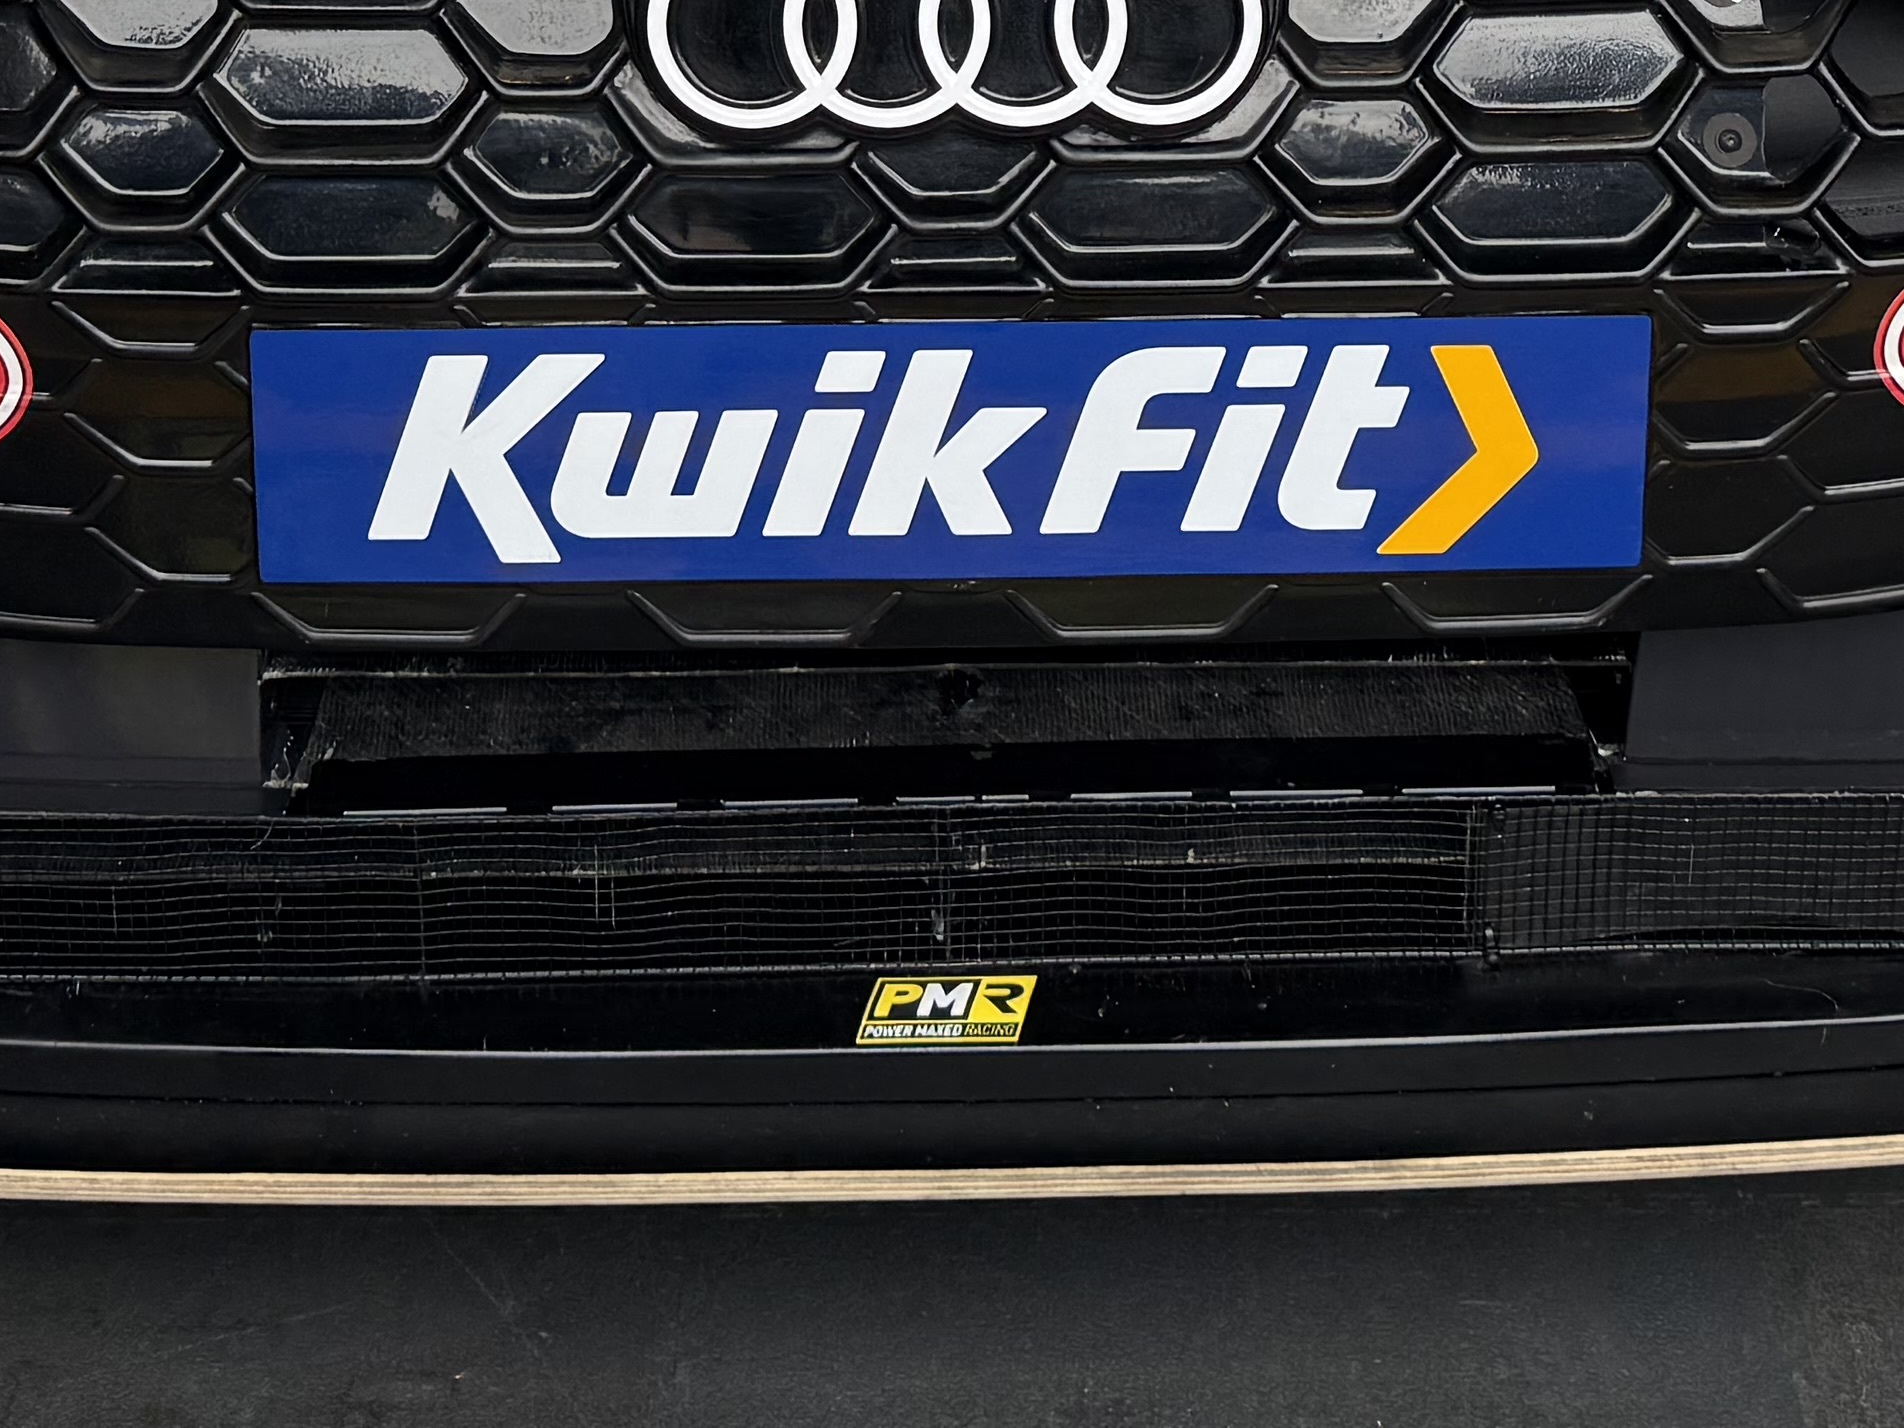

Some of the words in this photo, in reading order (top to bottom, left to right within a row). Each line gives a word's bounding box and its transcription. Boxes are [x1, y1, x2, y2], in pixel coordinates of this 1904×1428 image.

[873, 982, 1026, 1018] PMR
[864, 1025, 916, 1038] POWER
[915, 1024, 964, 1037] MAXED
[963, 1023, 1016, 1036] RACING
